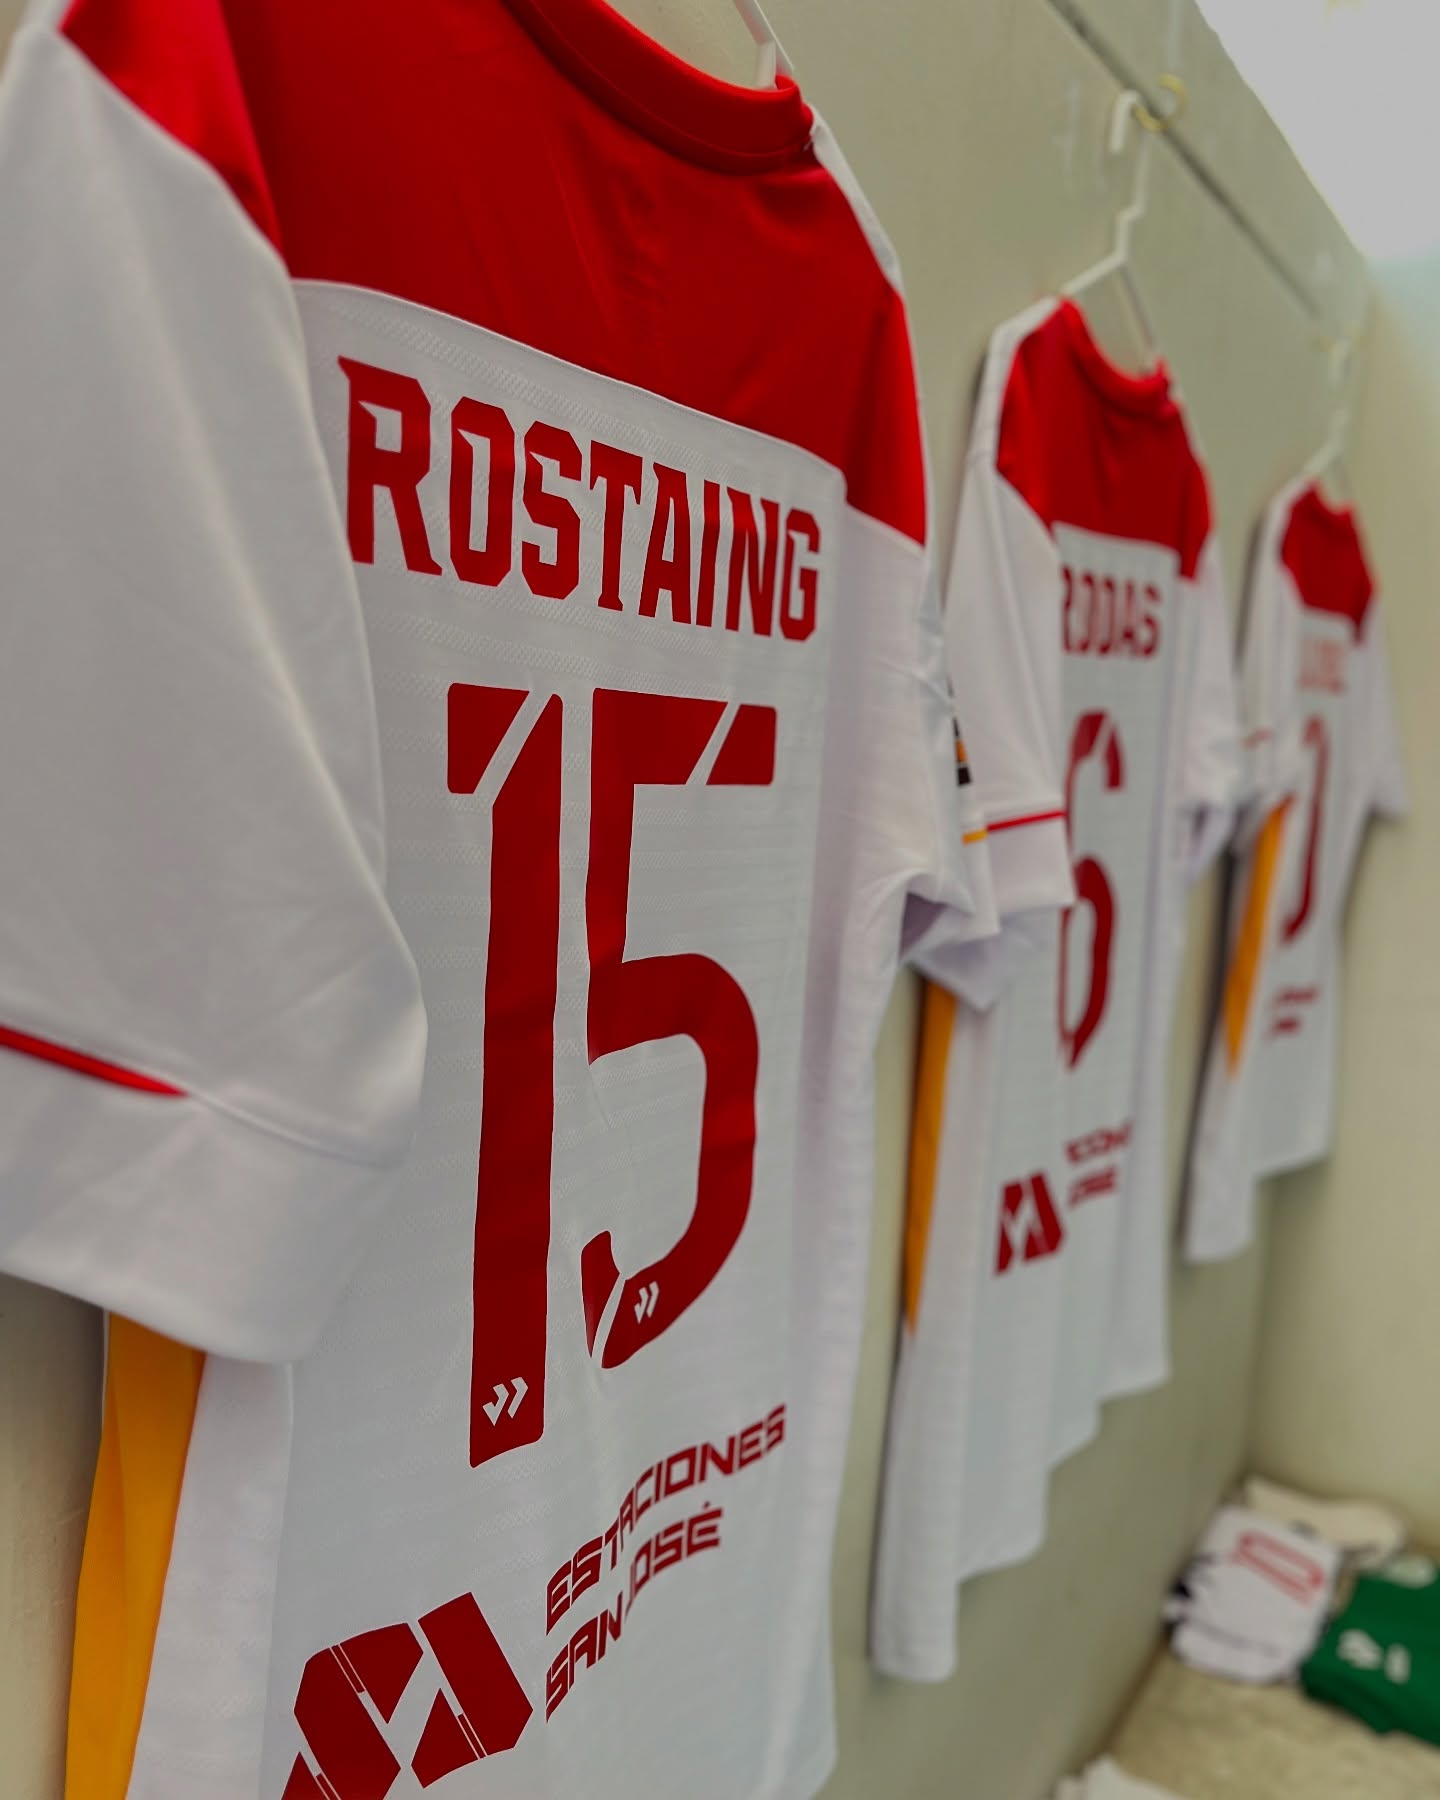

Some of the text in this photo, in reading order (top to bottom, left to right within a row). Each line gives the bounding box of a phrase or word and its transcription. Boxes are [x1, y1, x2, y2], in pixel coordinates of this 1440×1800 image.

[337, 355, 822, 643] ROSTAING
[446, 682, 778, 1469] 15
[545, 1500, 723, 1723] SAN JOSÉ
[546, 1403, 787, 1635] ESTACIONES
